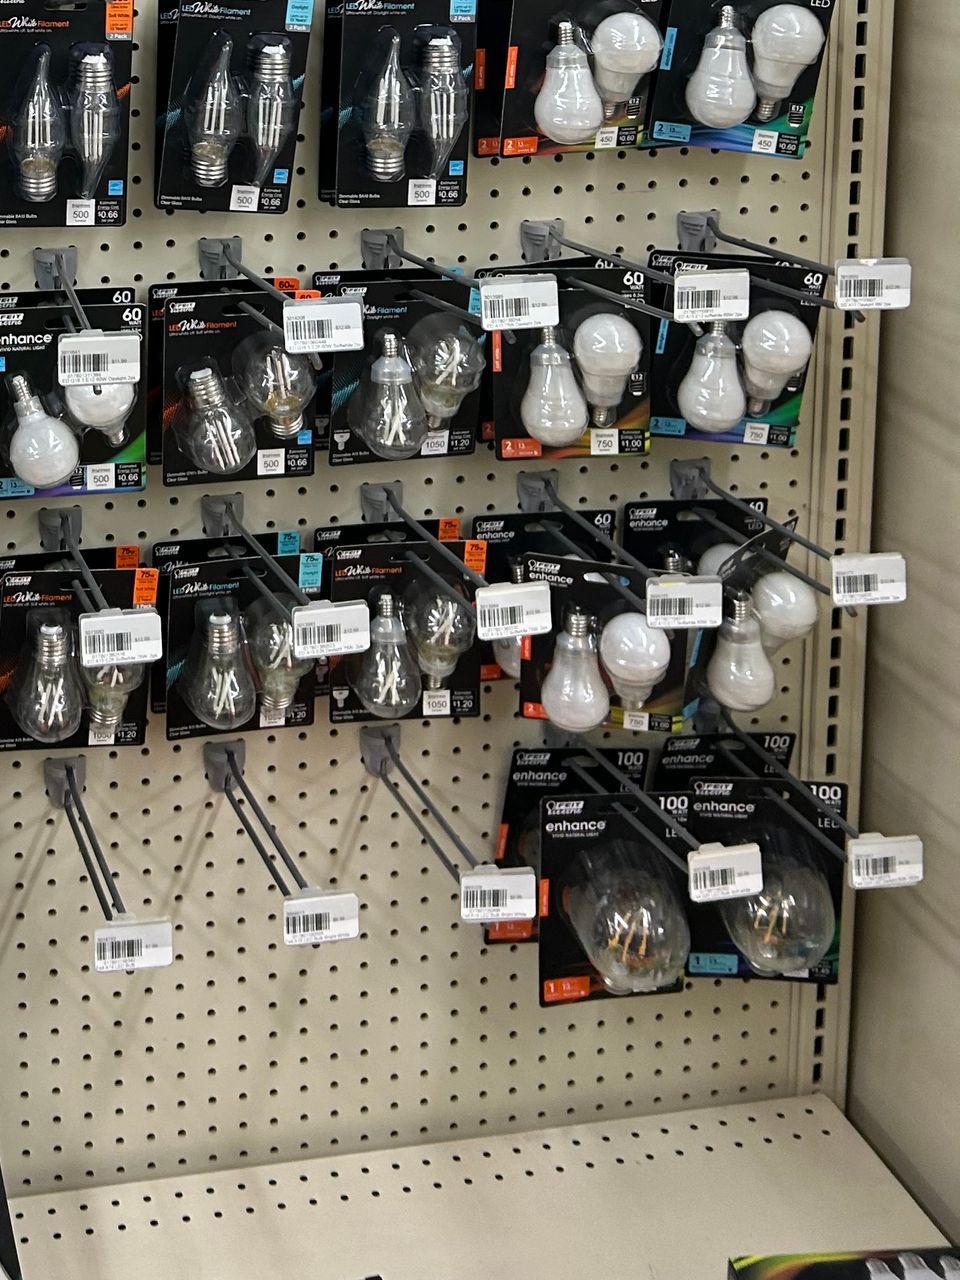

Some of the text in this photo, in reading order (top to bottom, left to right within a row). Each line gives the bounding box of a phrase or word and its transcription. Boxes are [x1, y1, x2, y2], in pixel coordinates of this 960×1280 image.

[414, 190, 430, 199] 500
[438, 191, 458, 200] $0.66
[624, 271, 645, 286] 60
[803, 274, 823, 285] 60
[112, 291, 131, 303] 60
[122, 308, 142, 321] 60
[597, 440, 613, 448] 750
[621, 439, 642, 448] $1.00
[93, 474, 109, 484] 500
[118, 473, 138, 482] $0.66
[594, 513, 611, 524] 60
[529, 572, 573, 585] enhance
[427, 700, 448, 709] 1050
[453, 700, 472, 708] $1.20
[659, 796, 689, 810] 100
[693, 801, 755, 813] enhance
[545, 820, 606, 832] enhance
